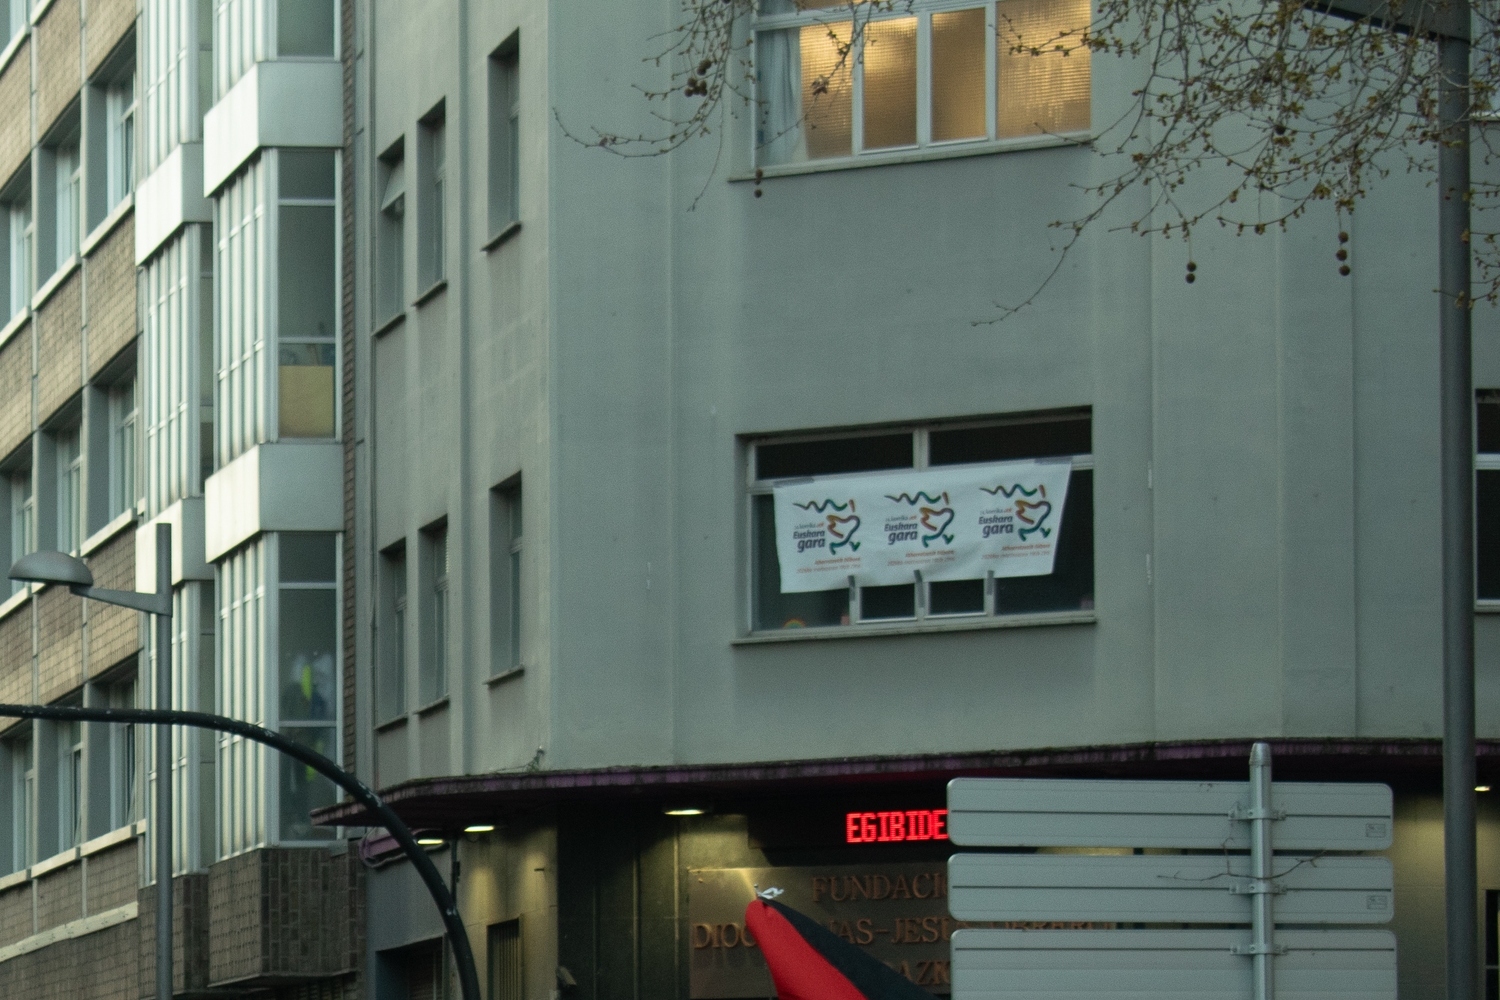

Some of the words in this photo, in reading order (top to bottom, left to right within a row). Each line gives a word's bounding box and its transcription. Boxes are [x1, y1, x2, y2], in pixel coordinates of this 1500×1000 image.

[884, 522, 918, 532] Euskara
[978, 515, 1013, 525] Euskara
[793, 530, 825, 539] Euskara
[888, 531, 918, 545] gara
[982, 524, 1013, 538] gara
[797, 538, 825, 553] gara
[846, 809, 949, 843] EGIBIDE
[811, 872, 949, 902] FUNDACI
